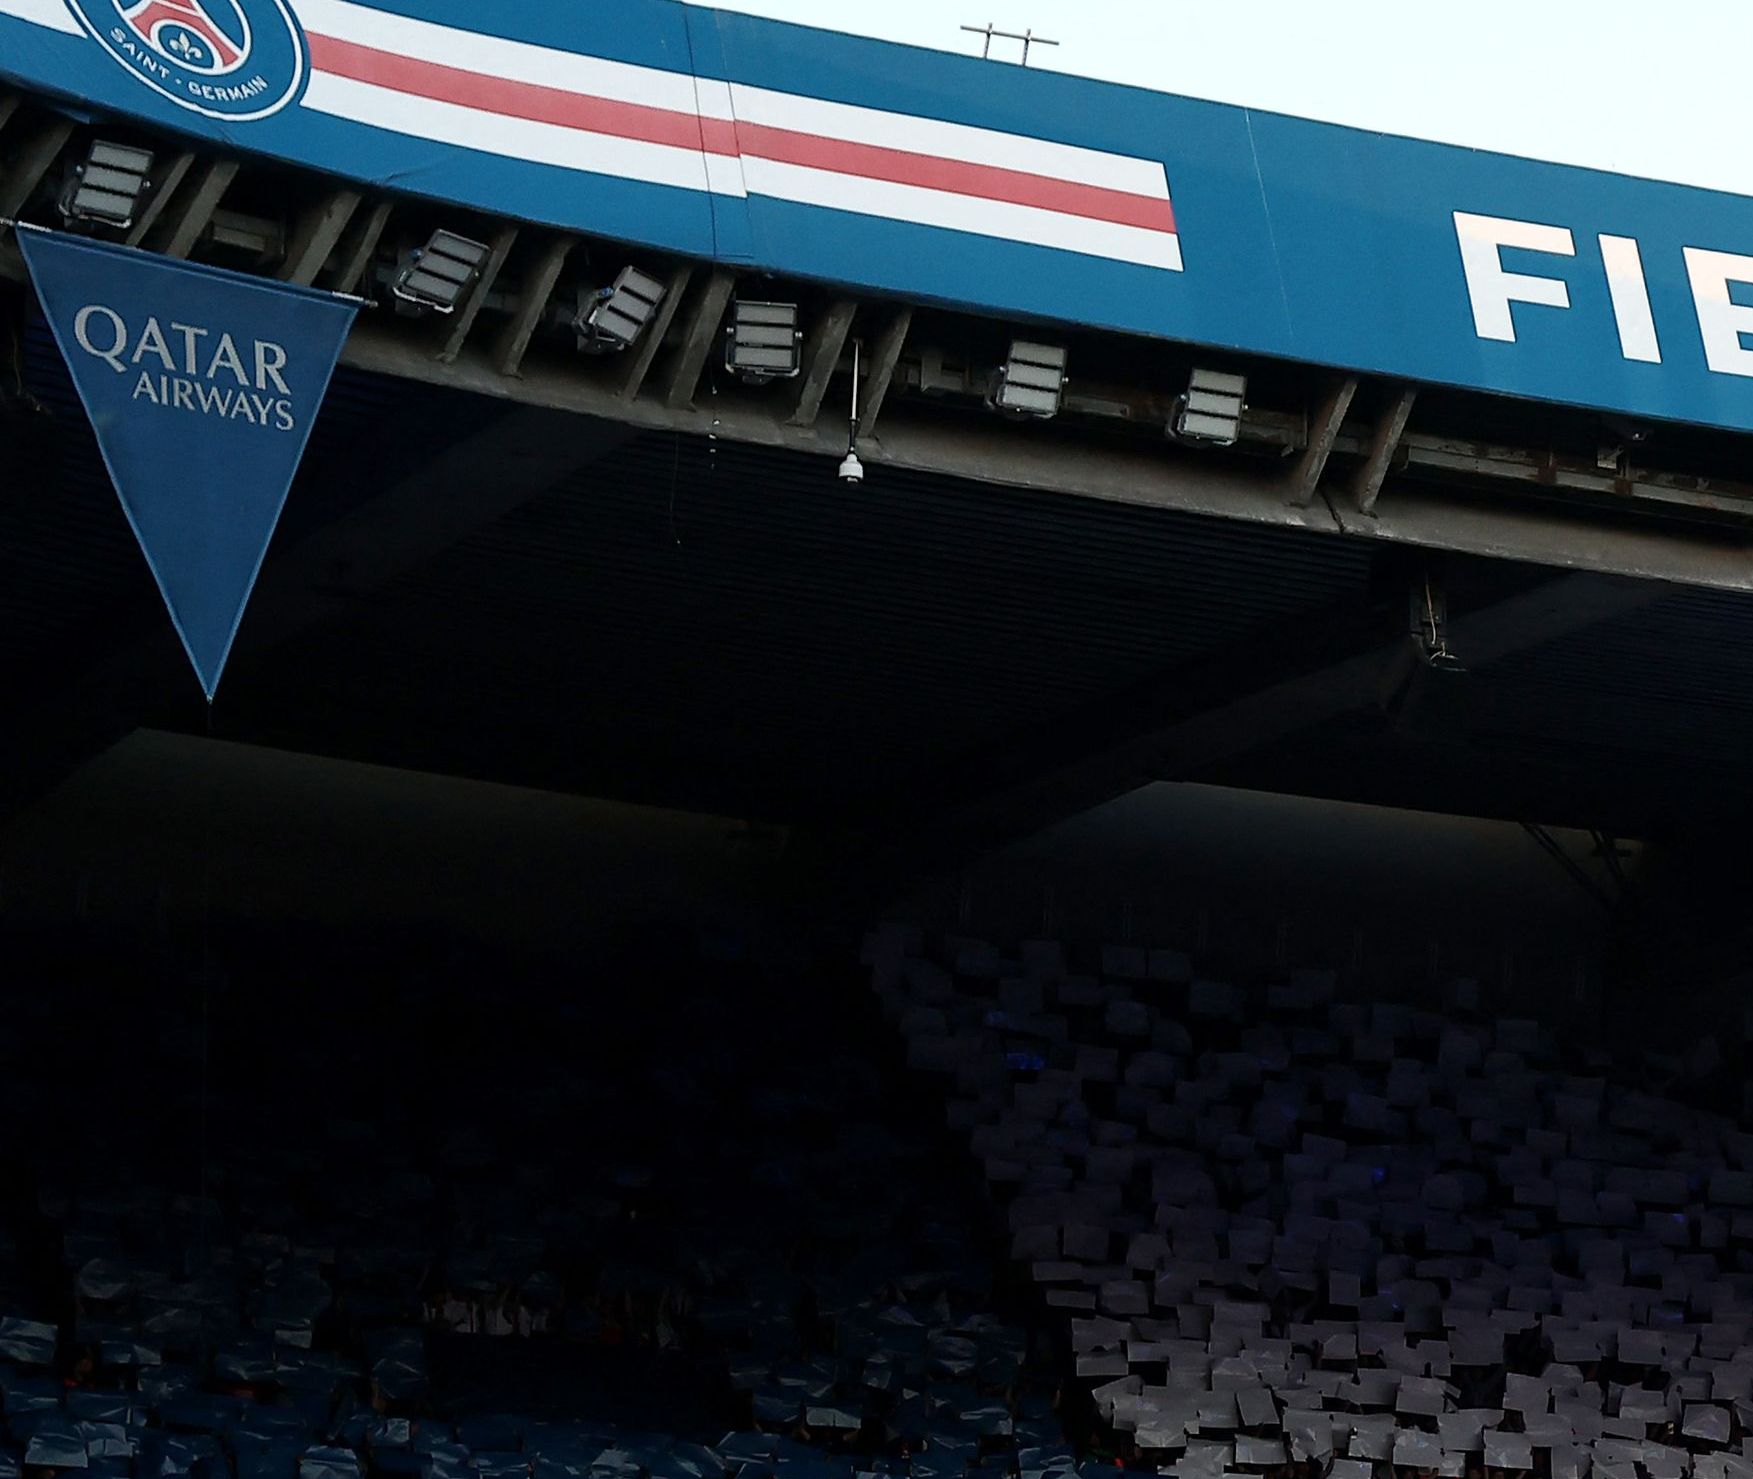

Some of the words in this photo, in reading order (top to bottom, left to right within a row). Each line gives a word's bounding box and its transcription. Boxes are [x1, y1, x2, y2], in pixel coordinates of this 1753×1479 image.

[110, 27, 170, 79] SAINT
[187, 75, 269, 101] GERMAIN
[73, 304, 291, 395] QATAR
[132, 373, 295, 431] AIRWAYS
